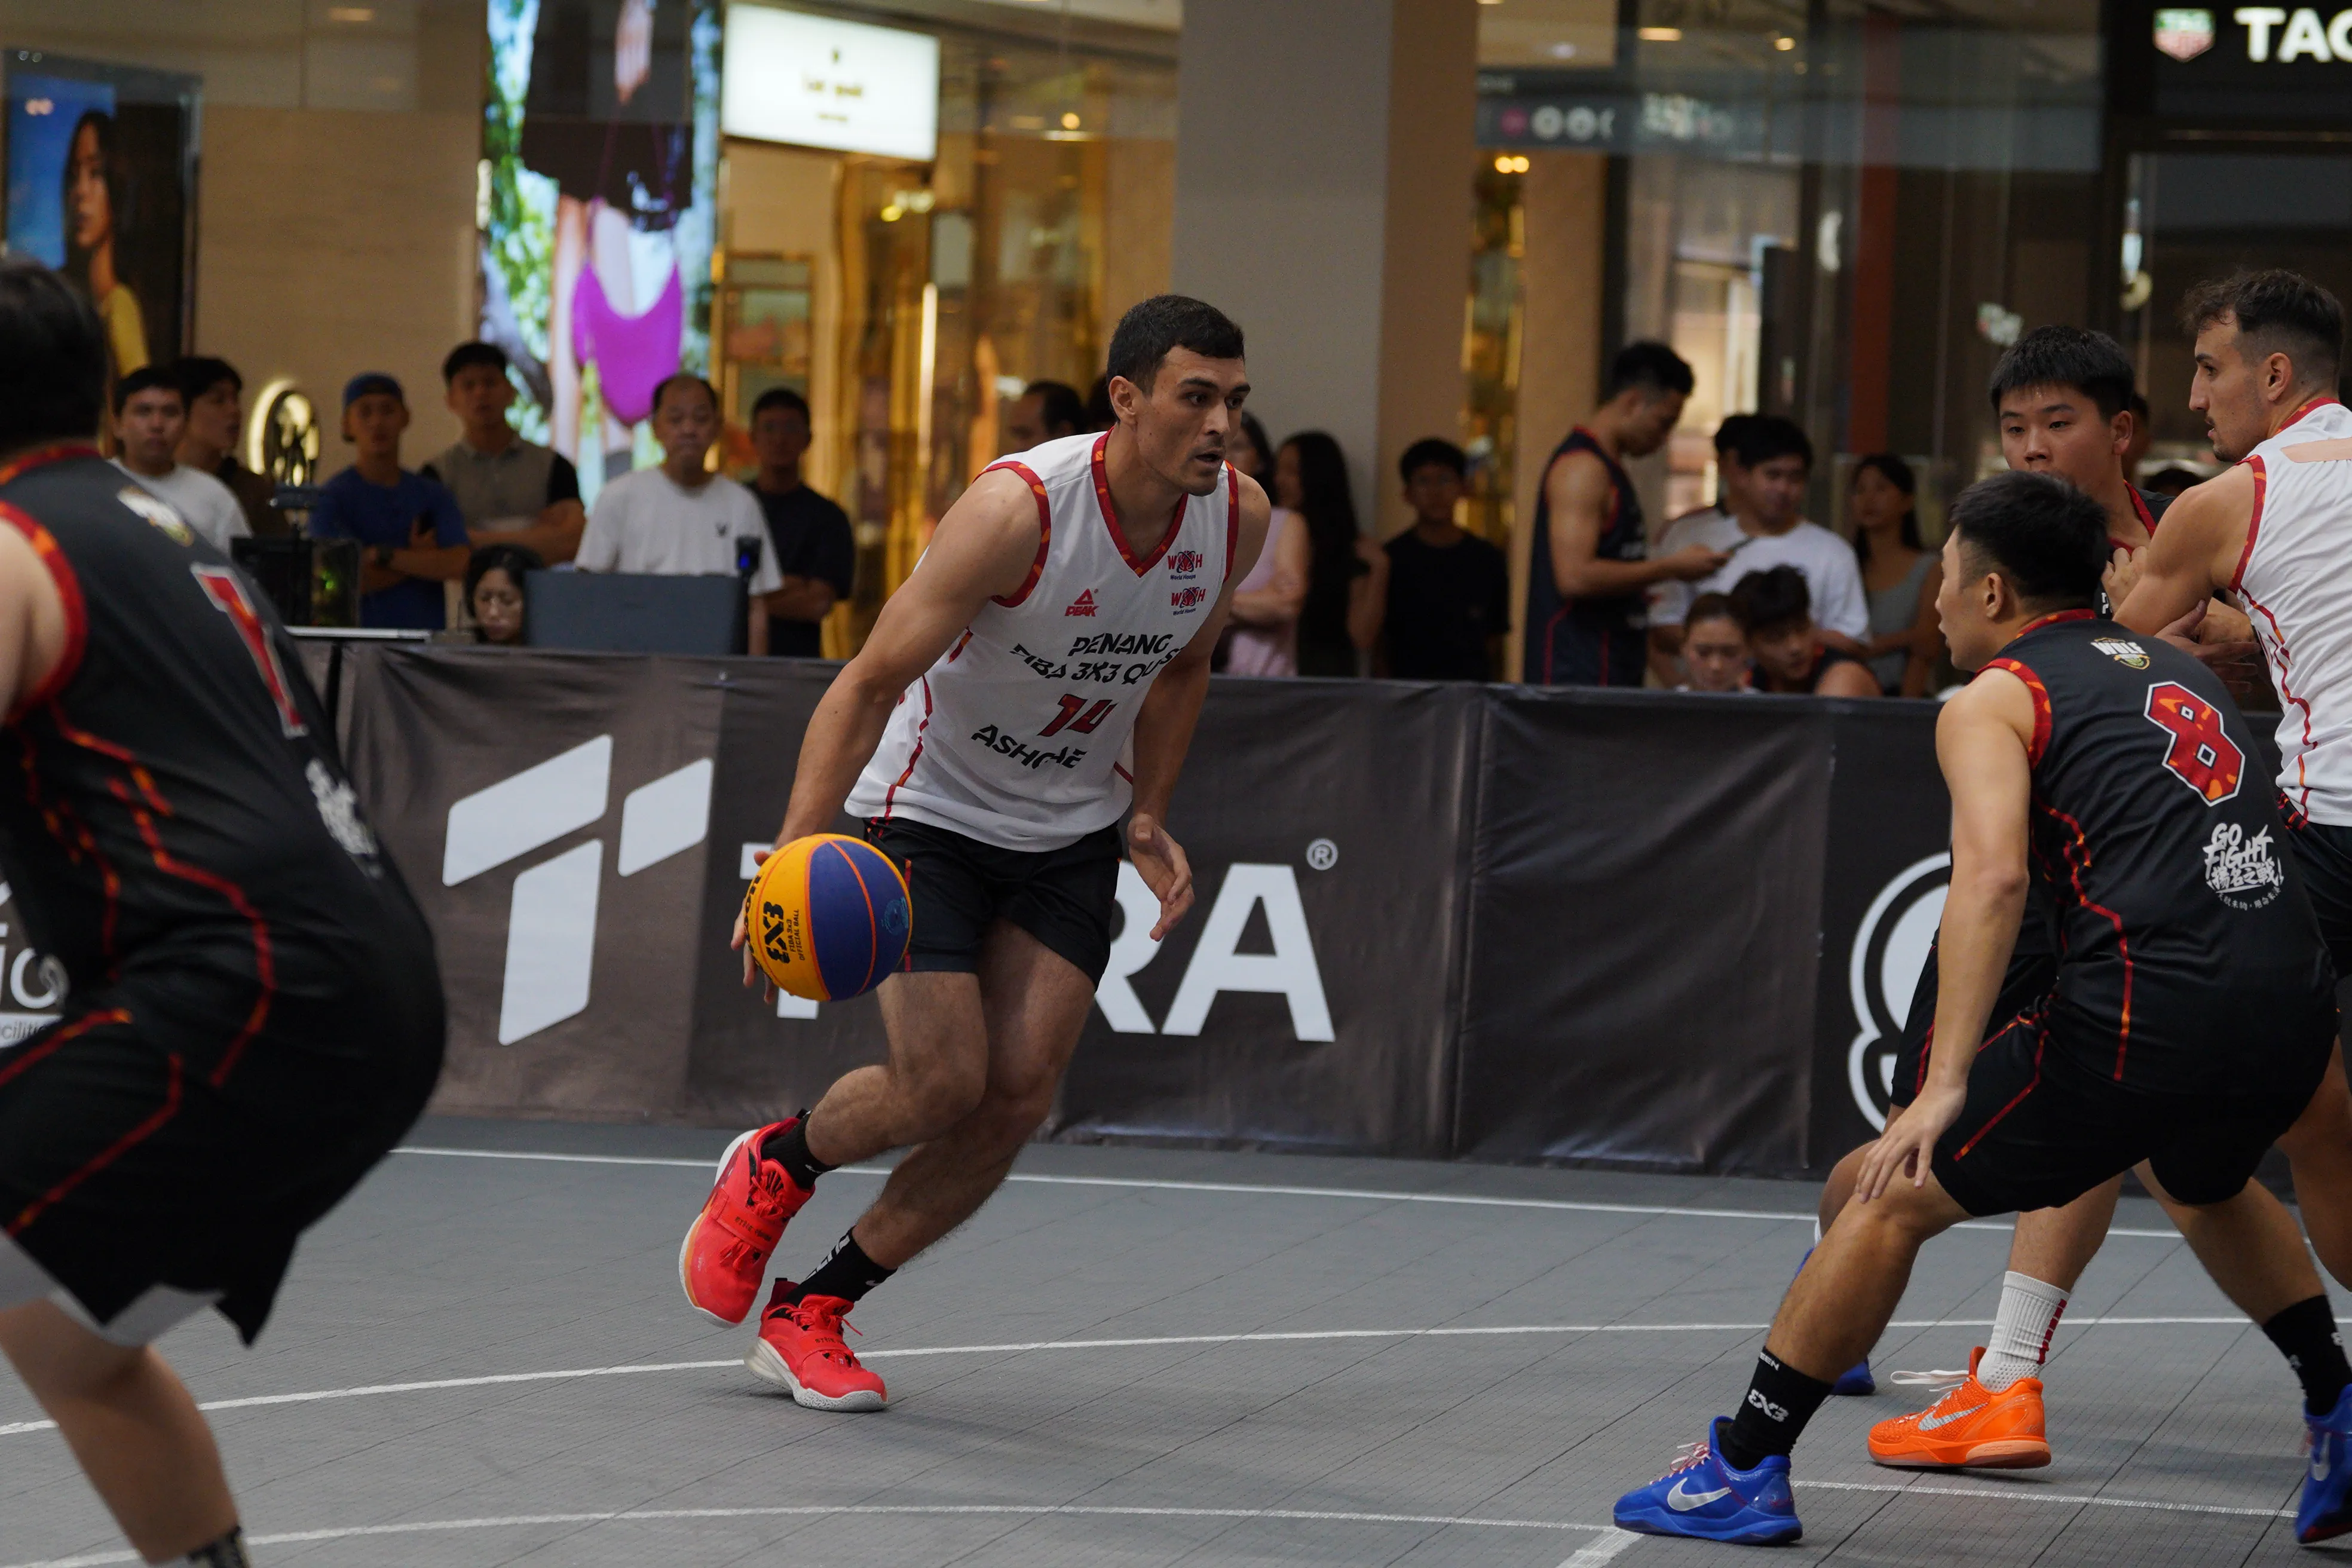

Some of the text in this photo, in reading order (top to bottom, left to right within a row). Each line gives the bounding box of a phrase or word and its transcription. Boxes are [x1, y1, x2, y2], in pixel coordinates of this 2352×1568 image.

[1064, 605, 1100, 617] PEAK
[1068, 633, 1173, 656] PENANG
[1071, 662, 1122, 683] 3X3
[1036, 694, 1119, 737] 14
[2143, 681, 2245, 807] 8
[2212, 823, 2242, 847] GO
[2203, 825, 2274, 880] FIGHT
